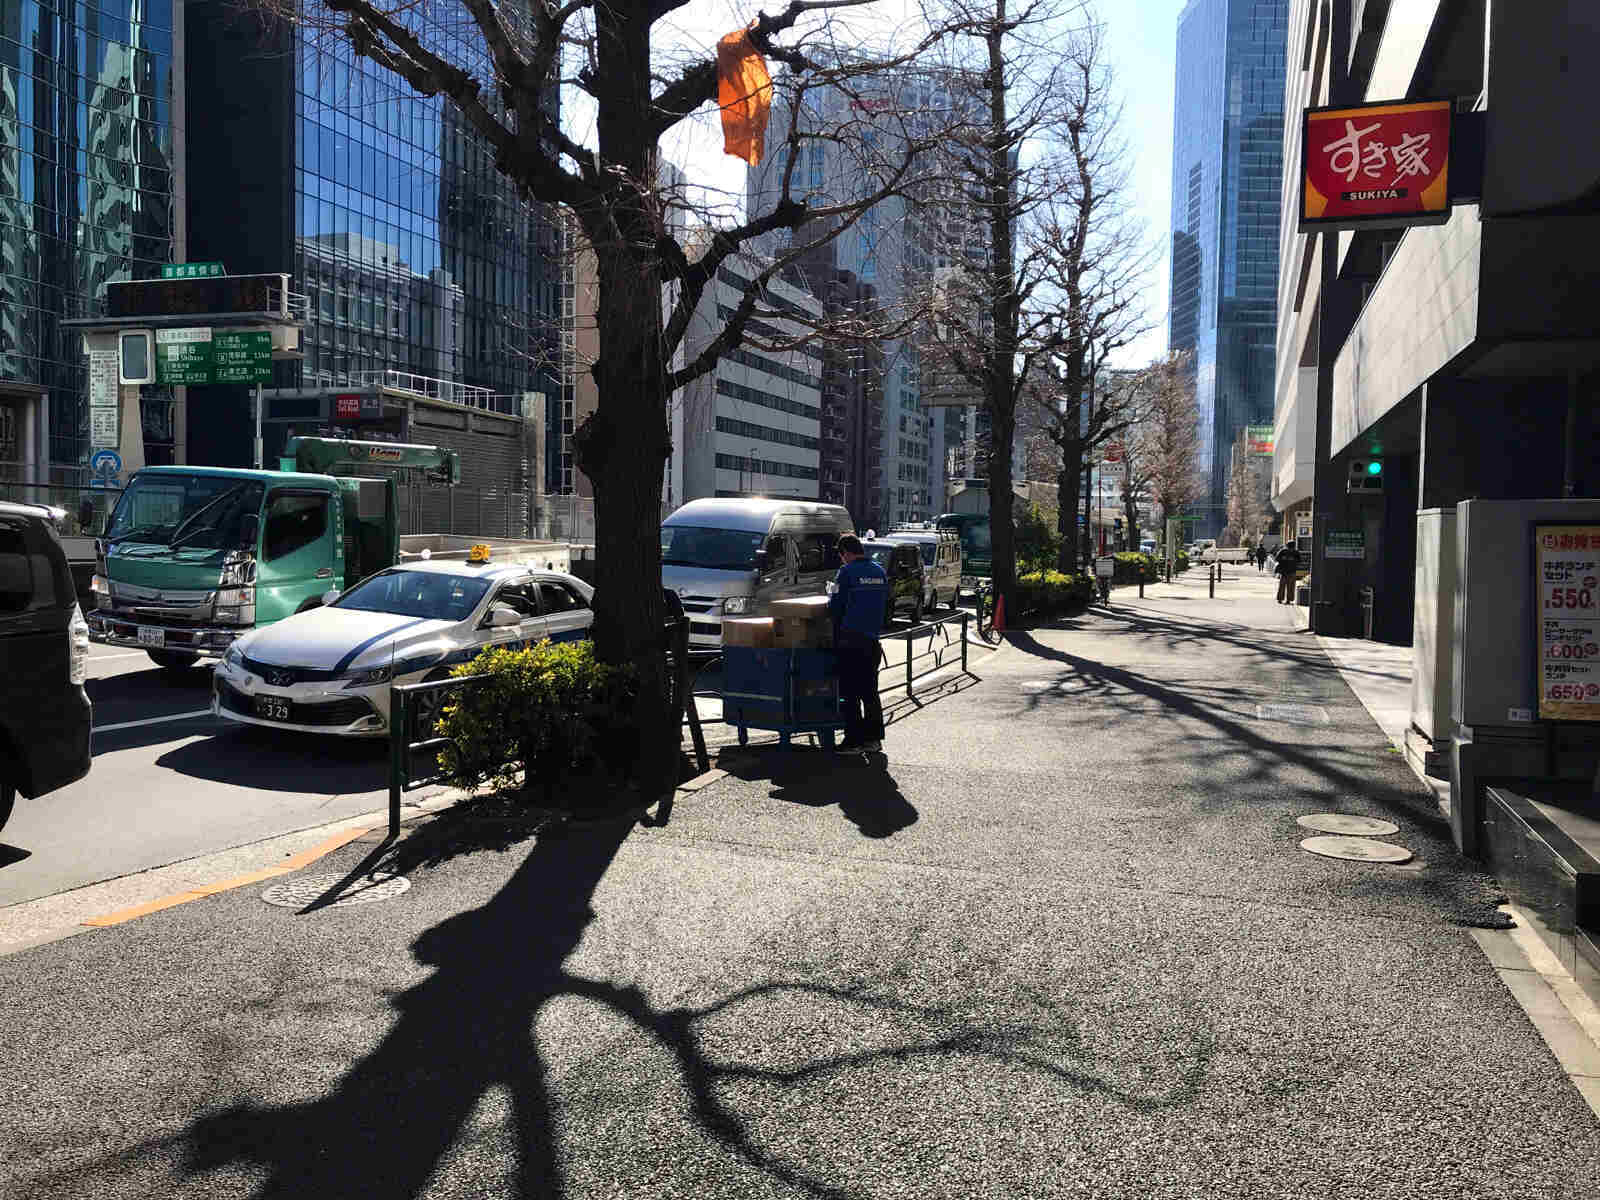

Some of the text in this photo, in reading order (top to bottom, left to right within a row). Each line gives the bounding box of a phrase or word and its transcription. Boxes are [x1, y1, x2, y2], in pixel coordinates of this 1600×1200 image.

[1322, 119, 1432, 187] すき家
[1349, 189, 1398, 201] SUKIYA
[1551, 588, 1591, 608] 550
[1551, 643, 1583, 658] 600
[1551, 683, 1584, 699] 650
